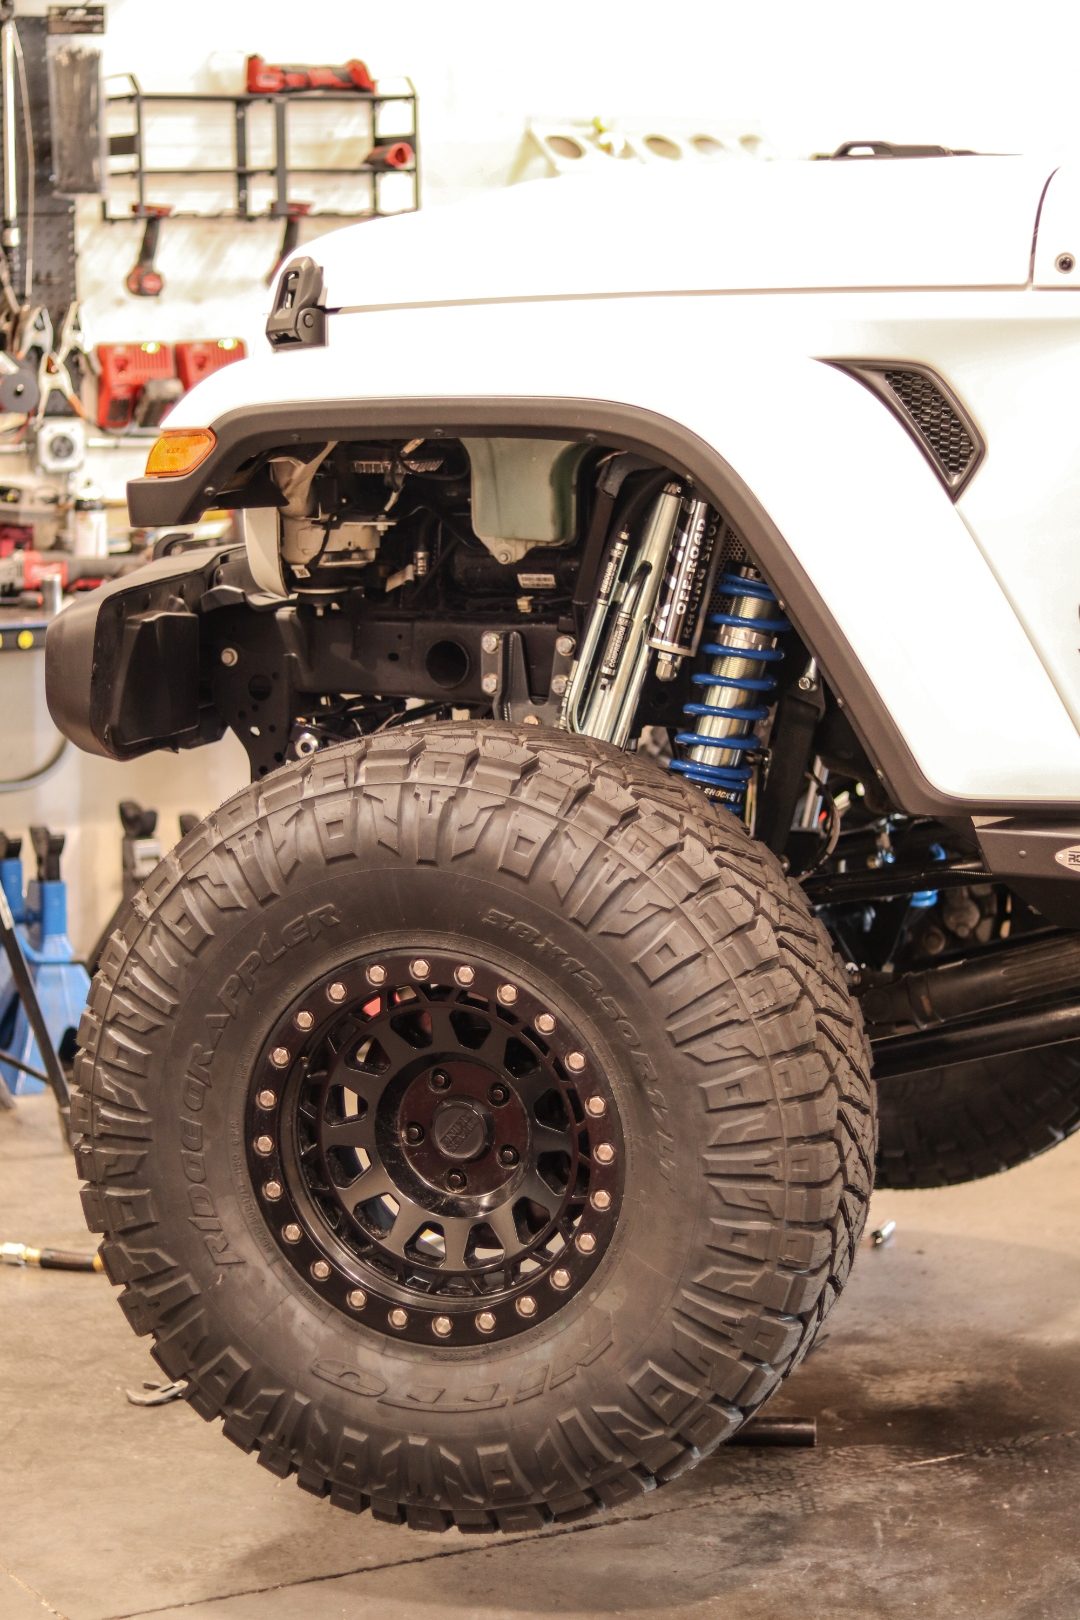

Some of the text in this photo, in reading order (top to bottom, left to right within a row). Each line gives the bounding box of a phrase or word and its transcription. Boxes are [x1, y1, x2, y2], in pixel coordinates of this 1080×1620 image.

[676, 517, 707, 616] OFF-ROAD
[683, 567, 707, 641] RACING
[609, 625, 627, 668] COMPRESSION
[704, 787, 736, 802] SHOCKS
[179, 902, 342, 1267] RIDGE GRAPPLER
[311, 1308, 614, 1413] NITTO
